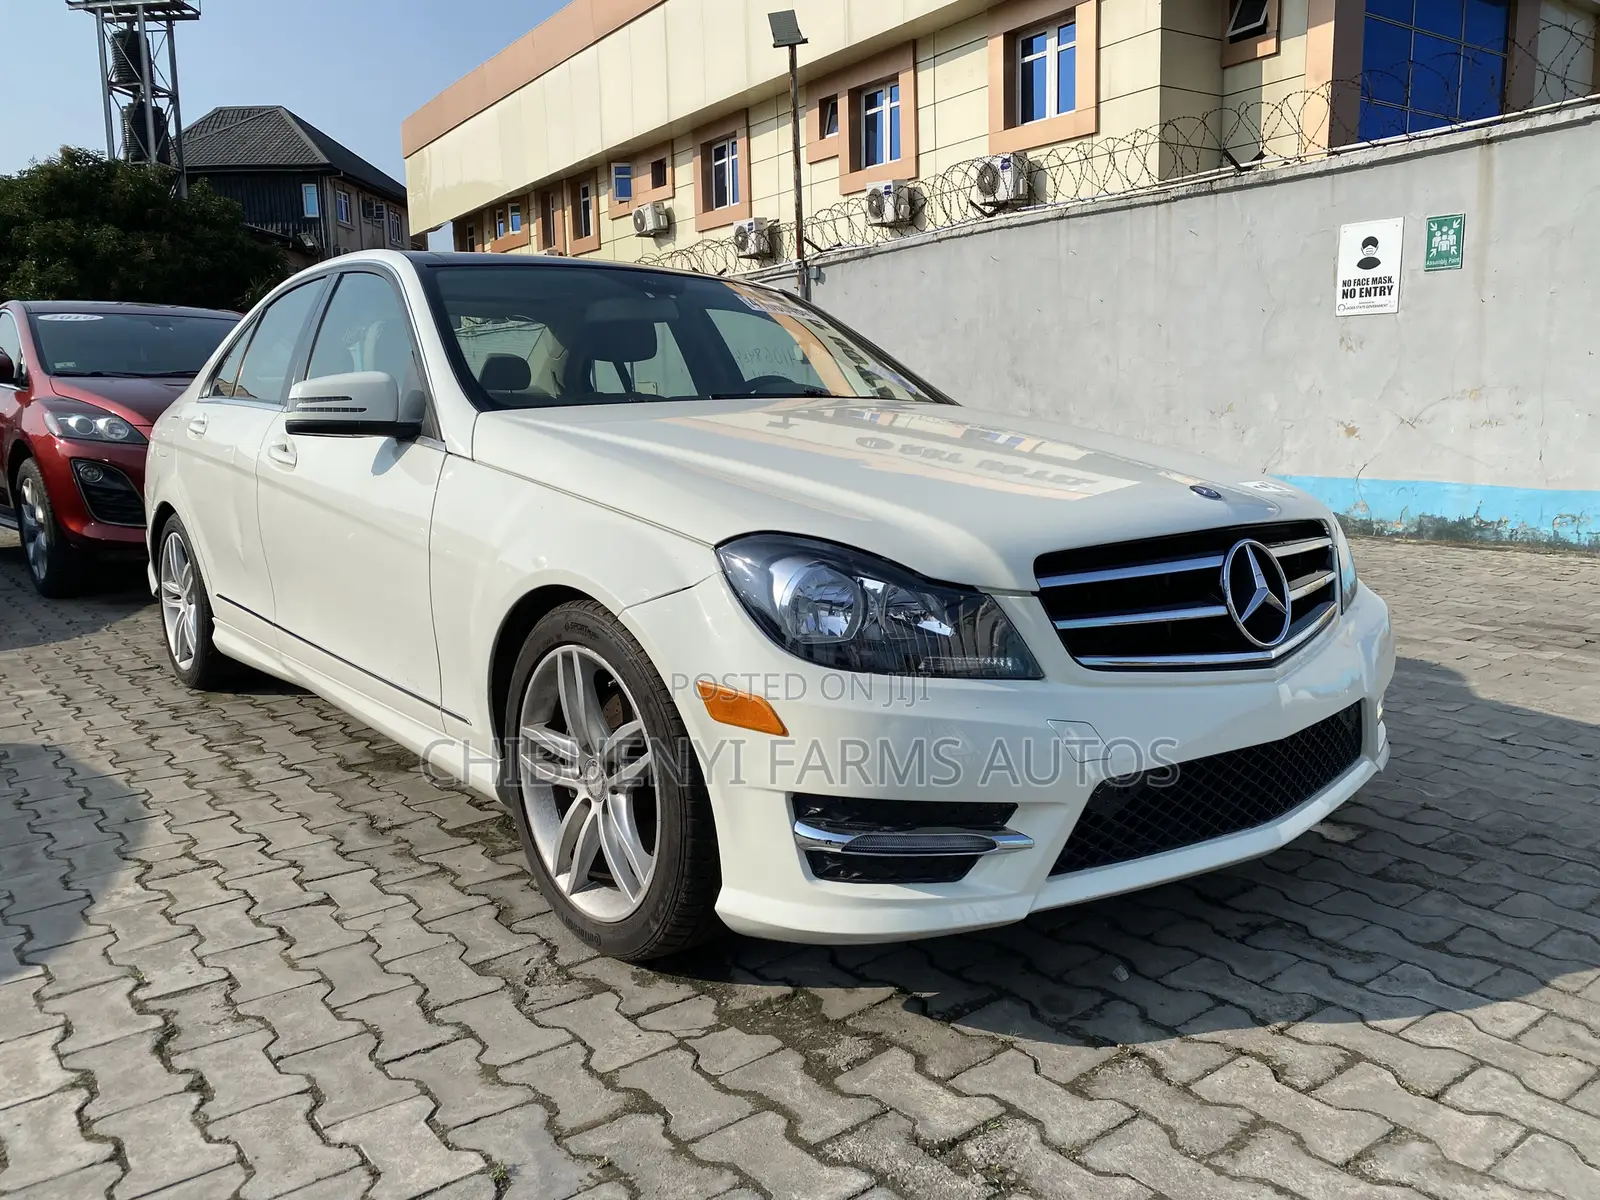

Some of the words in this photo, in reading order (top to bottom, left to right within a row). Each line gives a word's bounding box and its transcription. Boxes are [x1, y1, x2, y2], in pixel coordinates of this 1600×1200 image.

[1341, 279, 1352, 288] NO
[1353, 278, 1370, 287] FACE
[1341, 287, 1356, 300] NO
[1359, 285, 1394, 298] ENTRY
